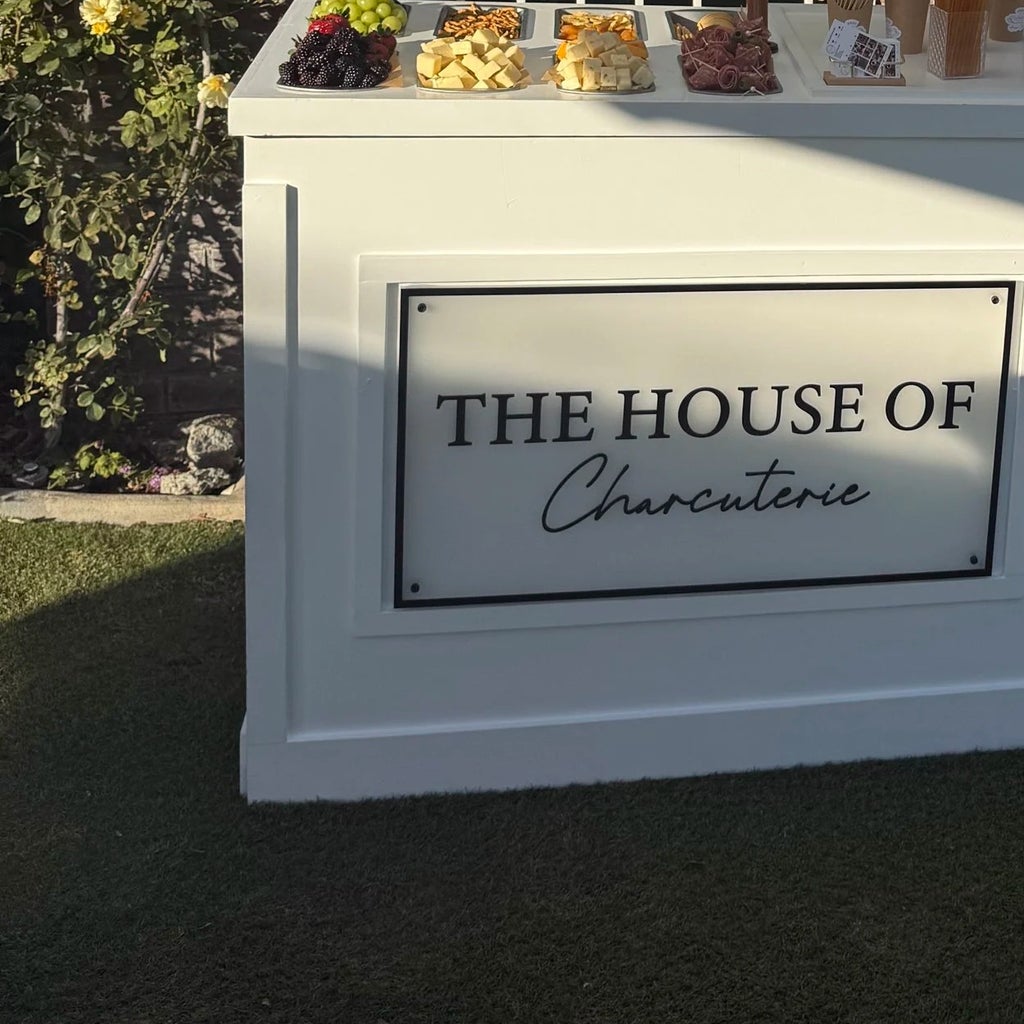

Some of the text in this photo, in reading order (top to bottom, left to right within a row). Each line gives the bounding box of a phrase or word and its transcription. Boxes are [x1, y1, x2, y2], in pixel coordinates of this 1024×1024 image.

[437, 380, 976, 447] THE HOUSE OF
[541, 453, 871, 534] Charcuterie
